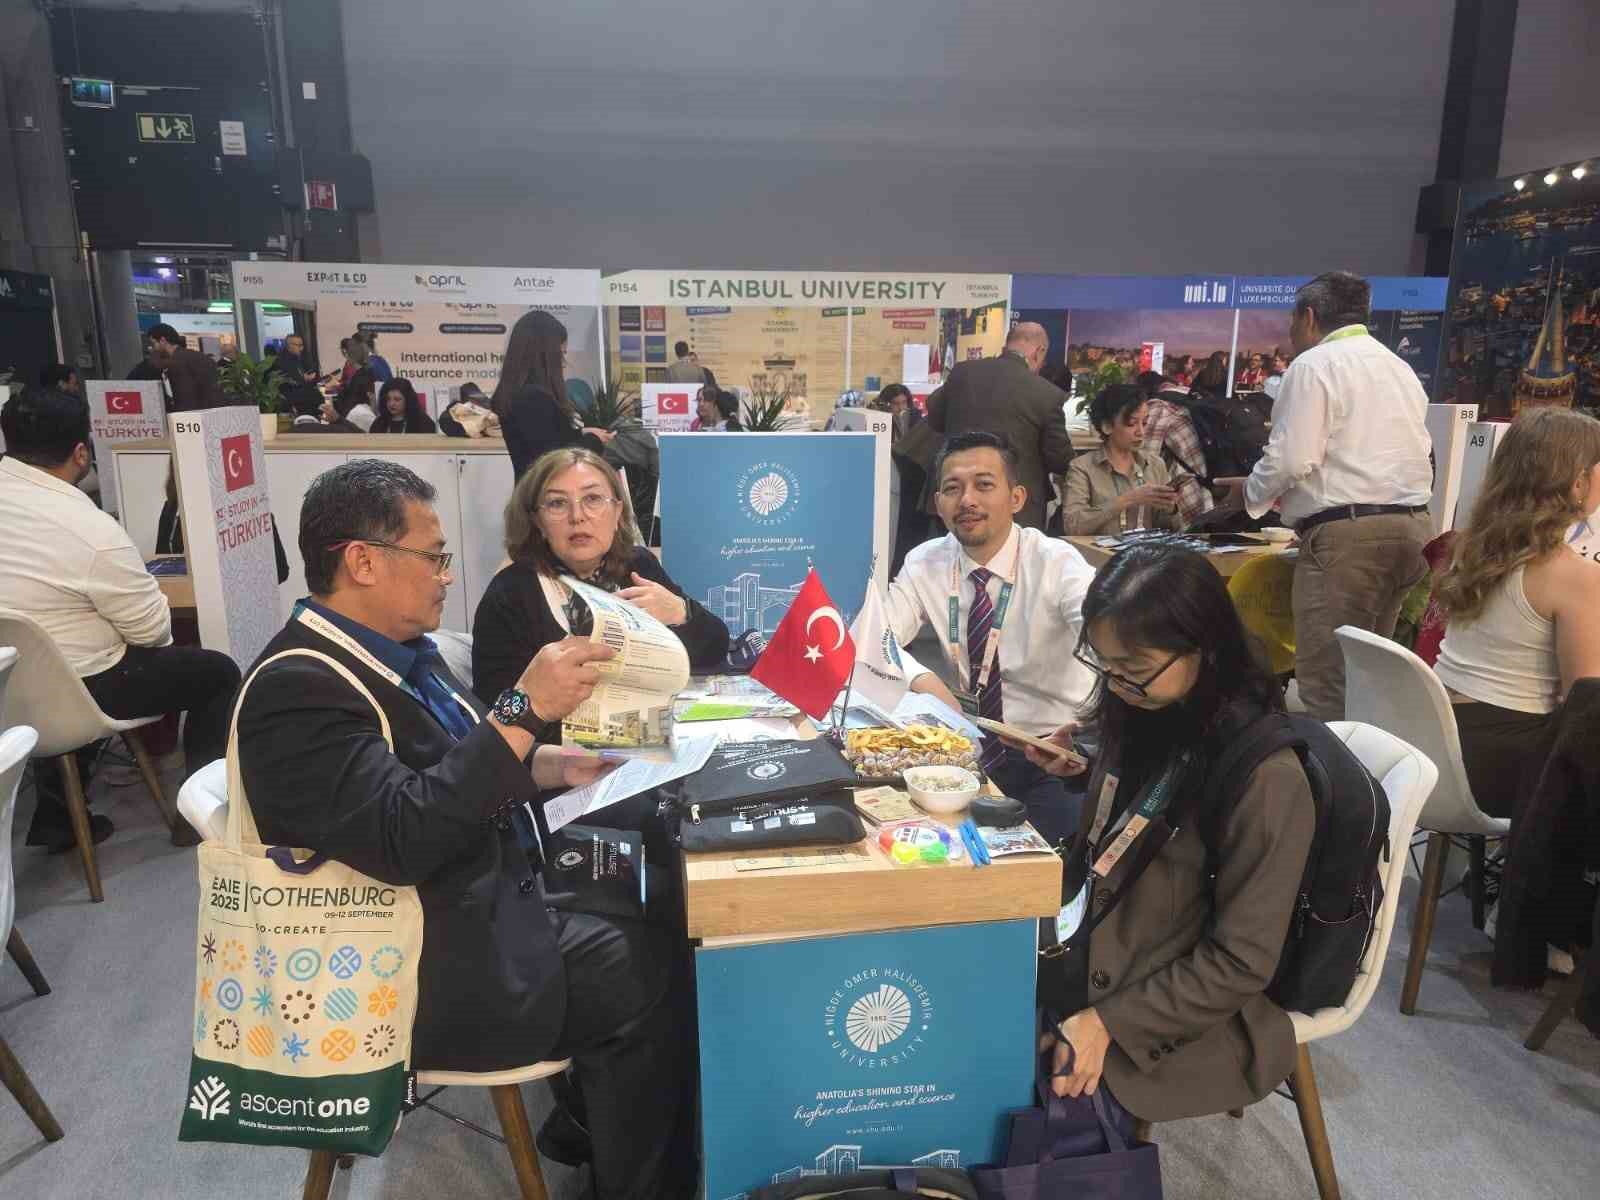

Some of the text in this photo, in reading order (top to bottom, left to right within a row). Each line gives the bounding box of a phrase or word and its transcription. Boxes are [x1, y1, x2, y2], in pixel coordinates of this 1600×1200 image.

[353, 273, 367, 284] CO
[610, 282, 638, 293] P154
[669, 280, 947, 300] ISTANBUL UNIVERSITY
[1183, 281, 1228, 303] uni.lu
[1284, 286, 1297, 294] DU
[1240, 295, 1296, 303] LUXEMBOURG
[396, 366, 463, 378] insurance
[1460, 410, 1474, 420] B8
[176, 423, 200, 433] B10
[872, 423, 887, 433] B9
[1470, 435, 1486, 447] A9
[212, 876, 241, 895] EAIE
[210, 892, 240, 911] 2025
[249, 885, 397, 907] GOTHENBURG
[348, 910, 394, 918] SEPTEMBER
[831, 1035, 923, 1069] UNIVERSITY
[866, 1086, 901, 1096] SHINING
[903, 1085, 924, 1095] STAR
[926, 1083, 937, 1092] IN
[793, 1092, 956, 1127] higher education and science
